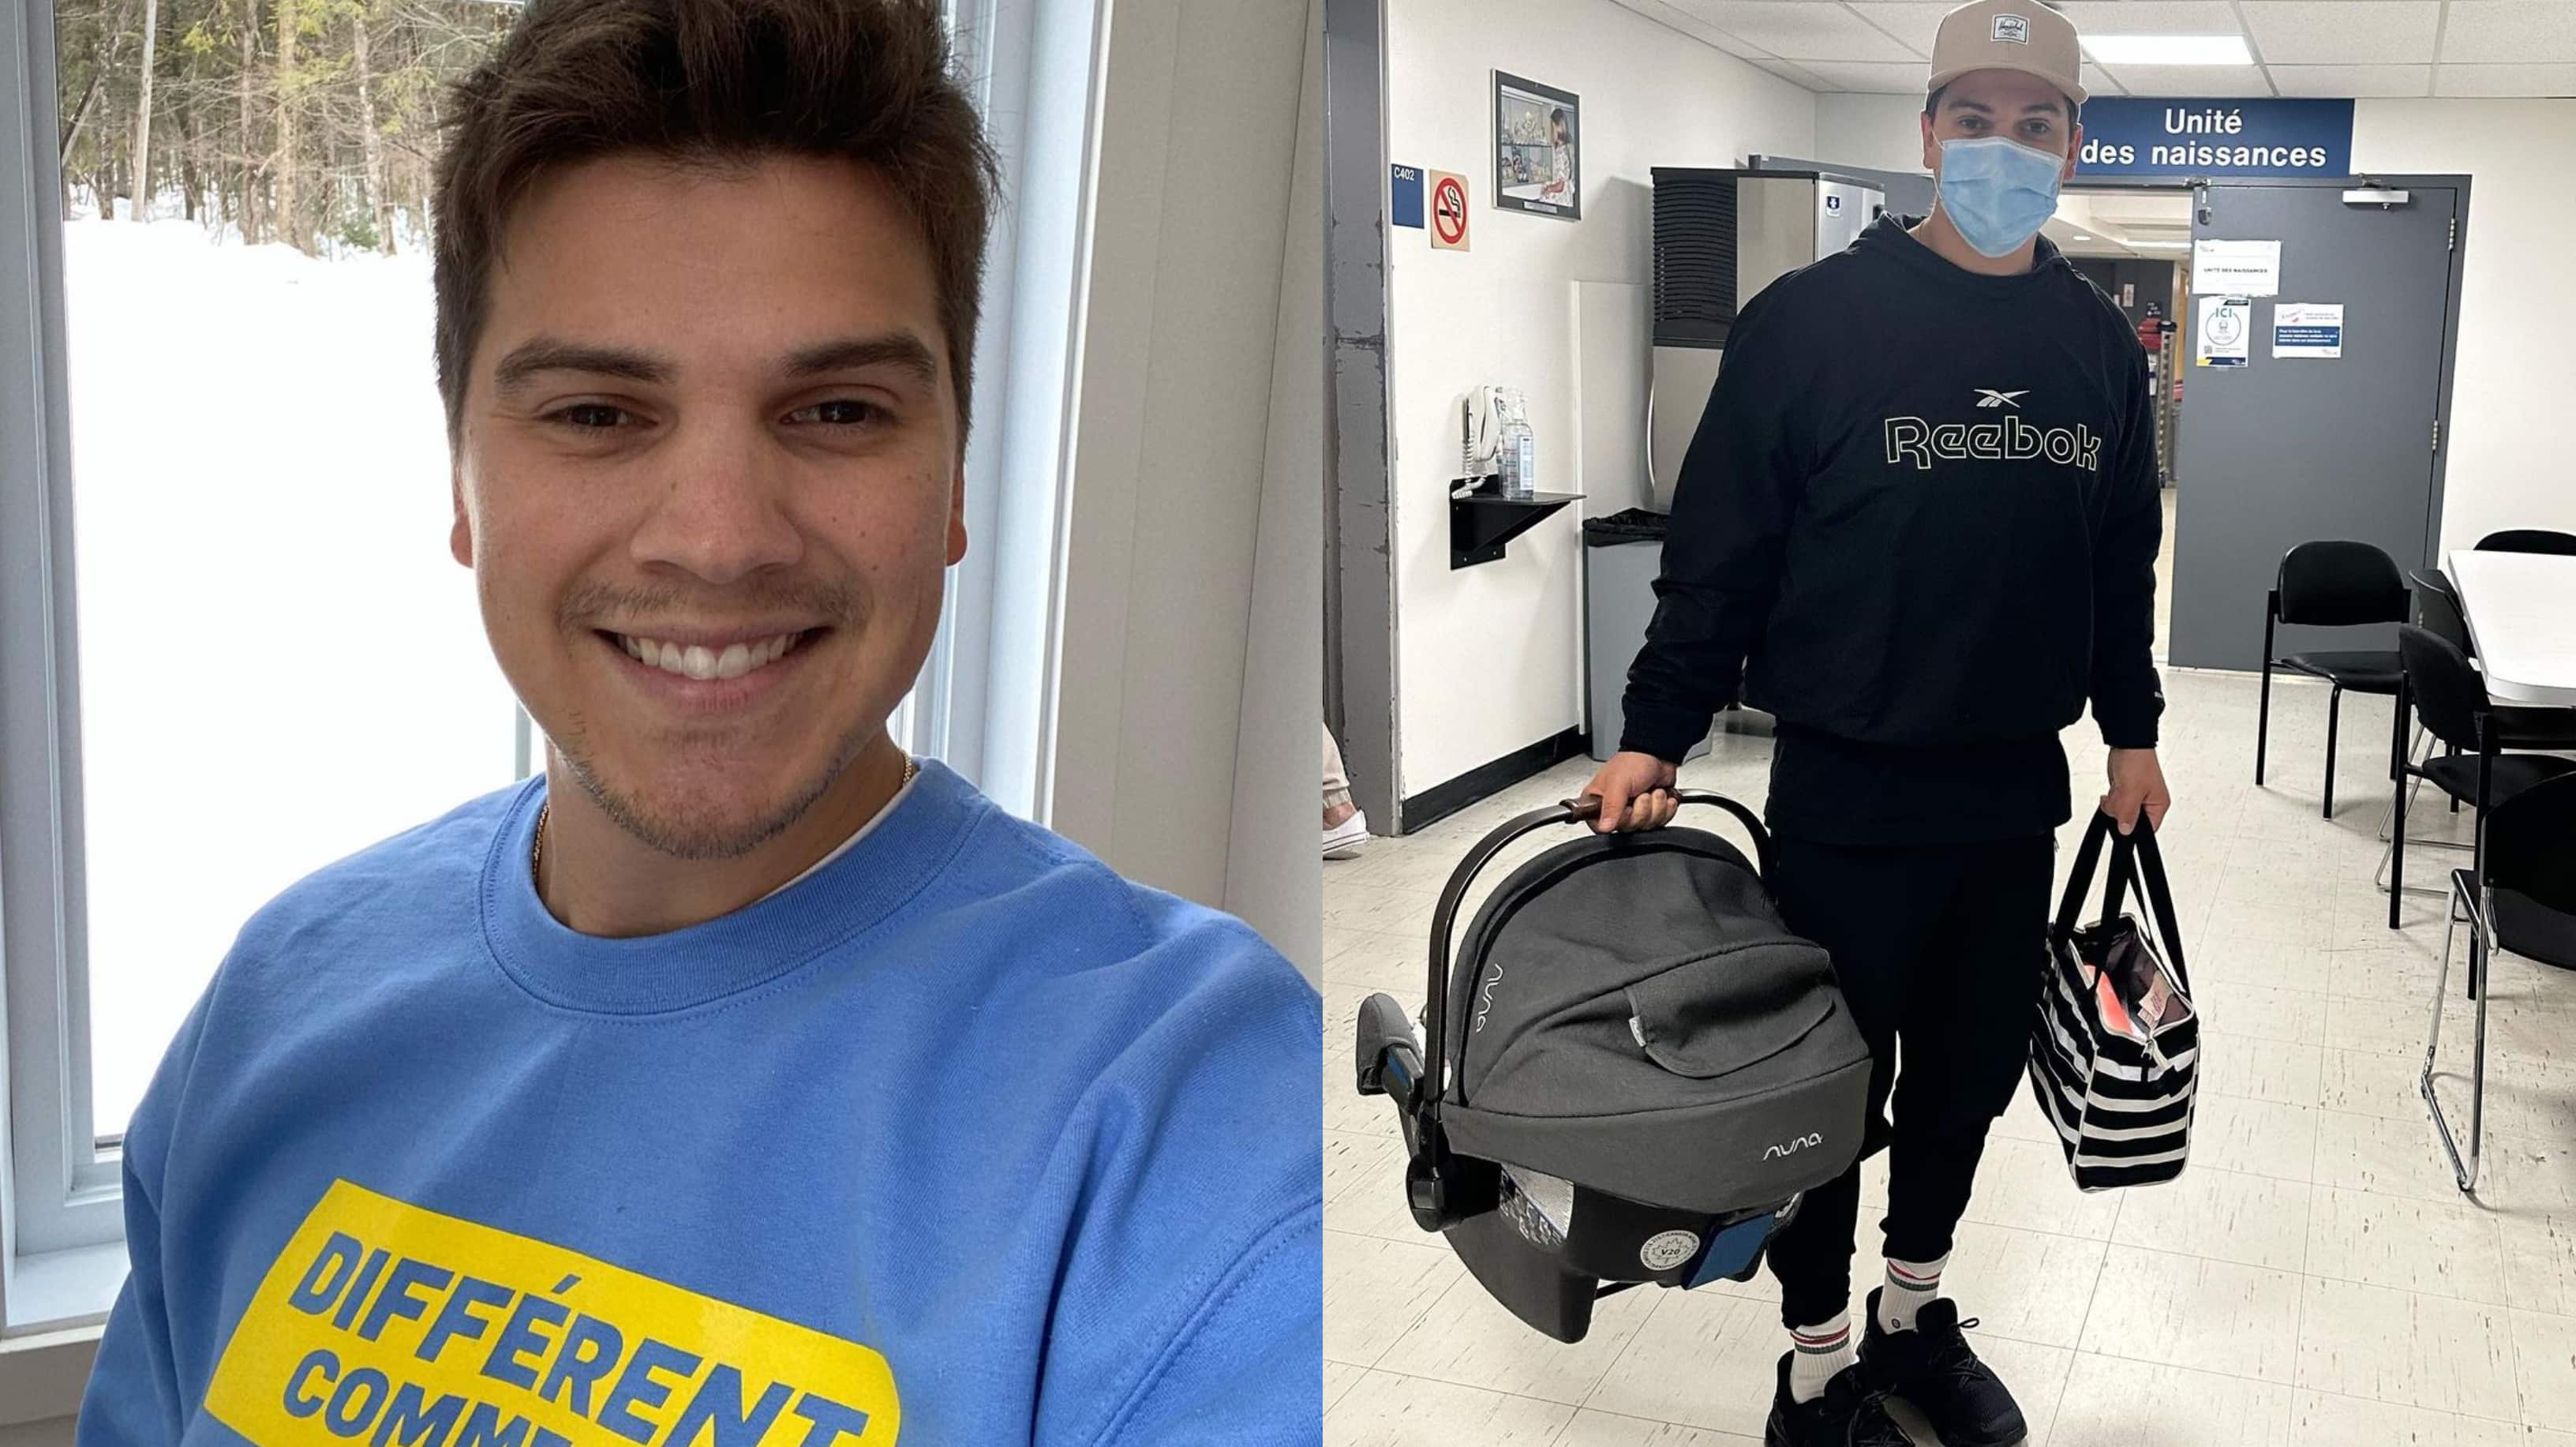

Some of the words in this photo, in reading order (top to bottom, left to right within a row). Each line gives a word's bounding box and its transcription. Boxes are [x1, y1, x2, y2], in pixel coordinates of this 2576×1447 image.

[2165, 108, 2243, 134] Unité
[2080, 139, 2136, 164] des
[2151, 141, 2327, 167] naissances
[1394, 167, 1415, 181] C402
[2215, 308, 2233, 318] ICI
[1885, 415, 2102, 471] Reebok
[1475, 963, 1503, 1033] nuna
[1762, 1132, 1824, 1161] nuna
[288, 1231, 871, 1447] DIFFÉRENT
[283, 1348, 573, 1447] COMM
